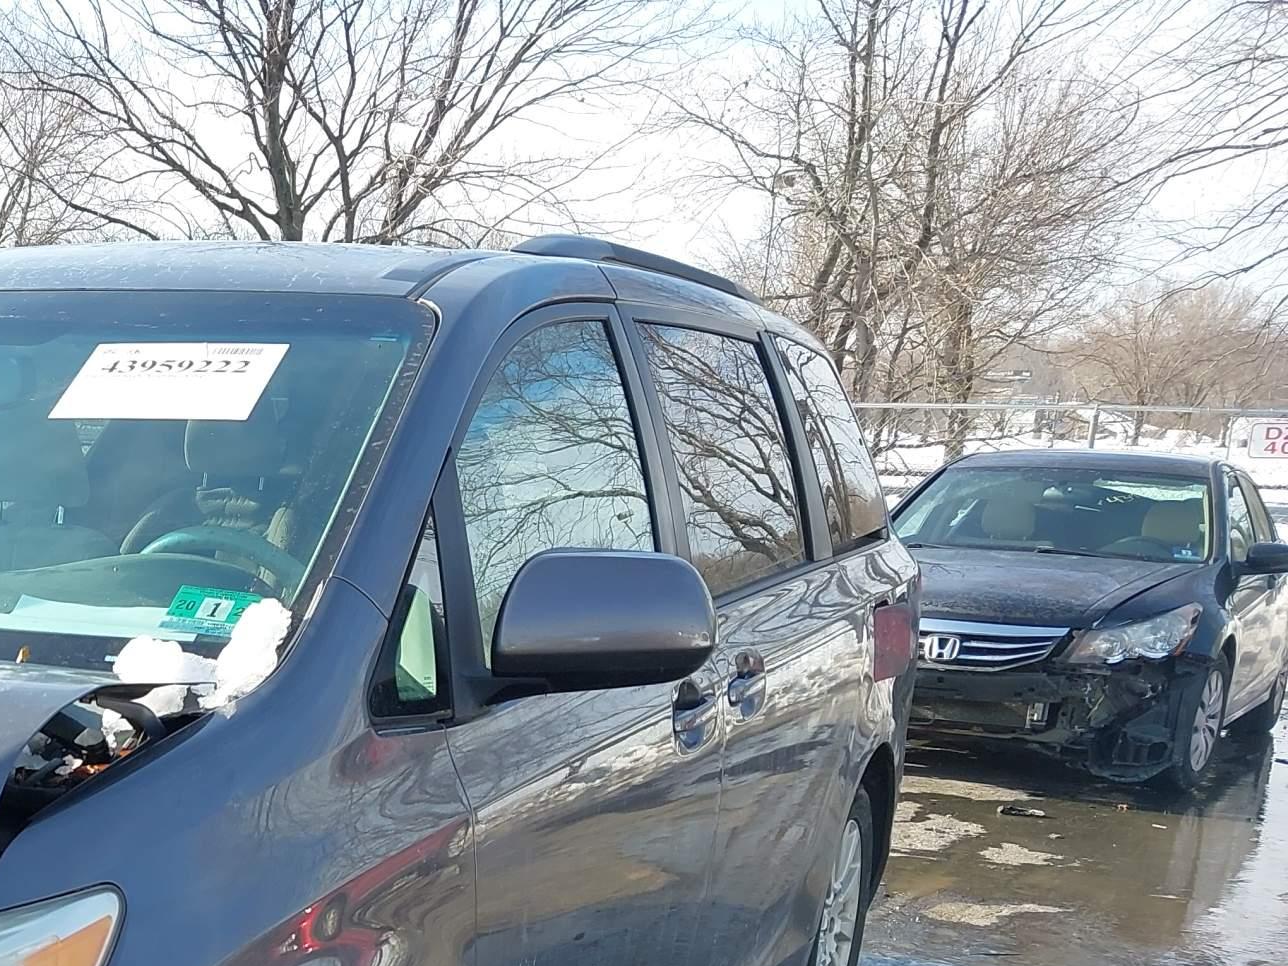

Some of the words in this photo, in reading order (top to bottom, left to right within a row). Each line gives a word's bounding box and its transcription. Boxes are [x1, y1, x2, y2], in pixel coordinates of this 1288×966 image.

[101, 359, 250, 374] 43959222
[1265, 426, 1288, 441] D
[176, 599, 196, 611] 20
[206, 602, 223, 618] 1
